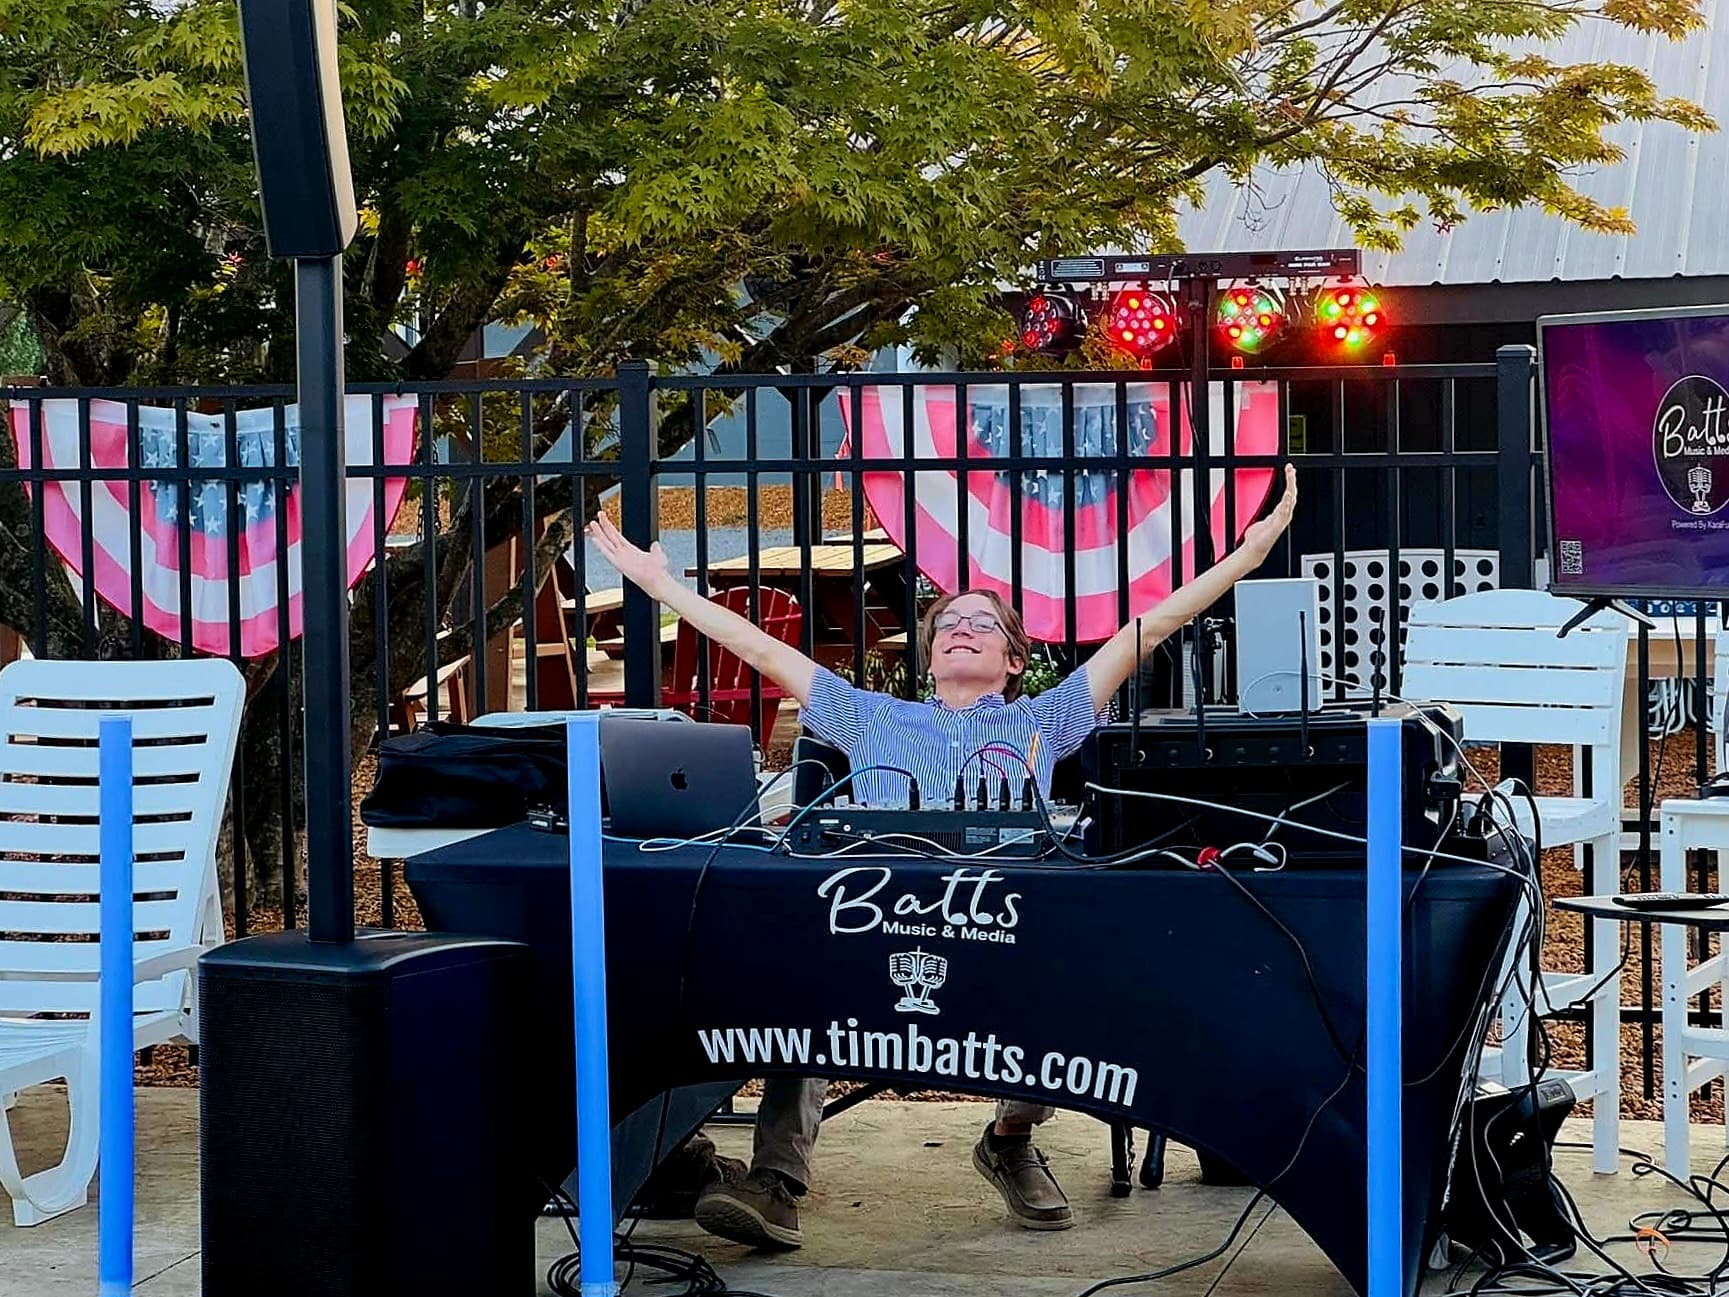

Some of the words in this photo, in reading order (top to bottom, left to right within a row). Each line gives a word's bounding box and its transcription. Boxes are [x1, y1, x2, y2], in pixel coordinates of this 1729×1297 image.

[1684, 446, 1706, 455] Music
[1706, 446, 1713, 455] &
[1671, 520, 1698, 529] Powered
[1698, 520, 1706, 531] By
[817, 867, 1022, 935] Batts
[882, 921, 937, 937] Music
[941, 925, 956, 938] &
[960, 926, 1017, 945] Media
[697, 1017, 1139, 1108] www.timbatts.com
